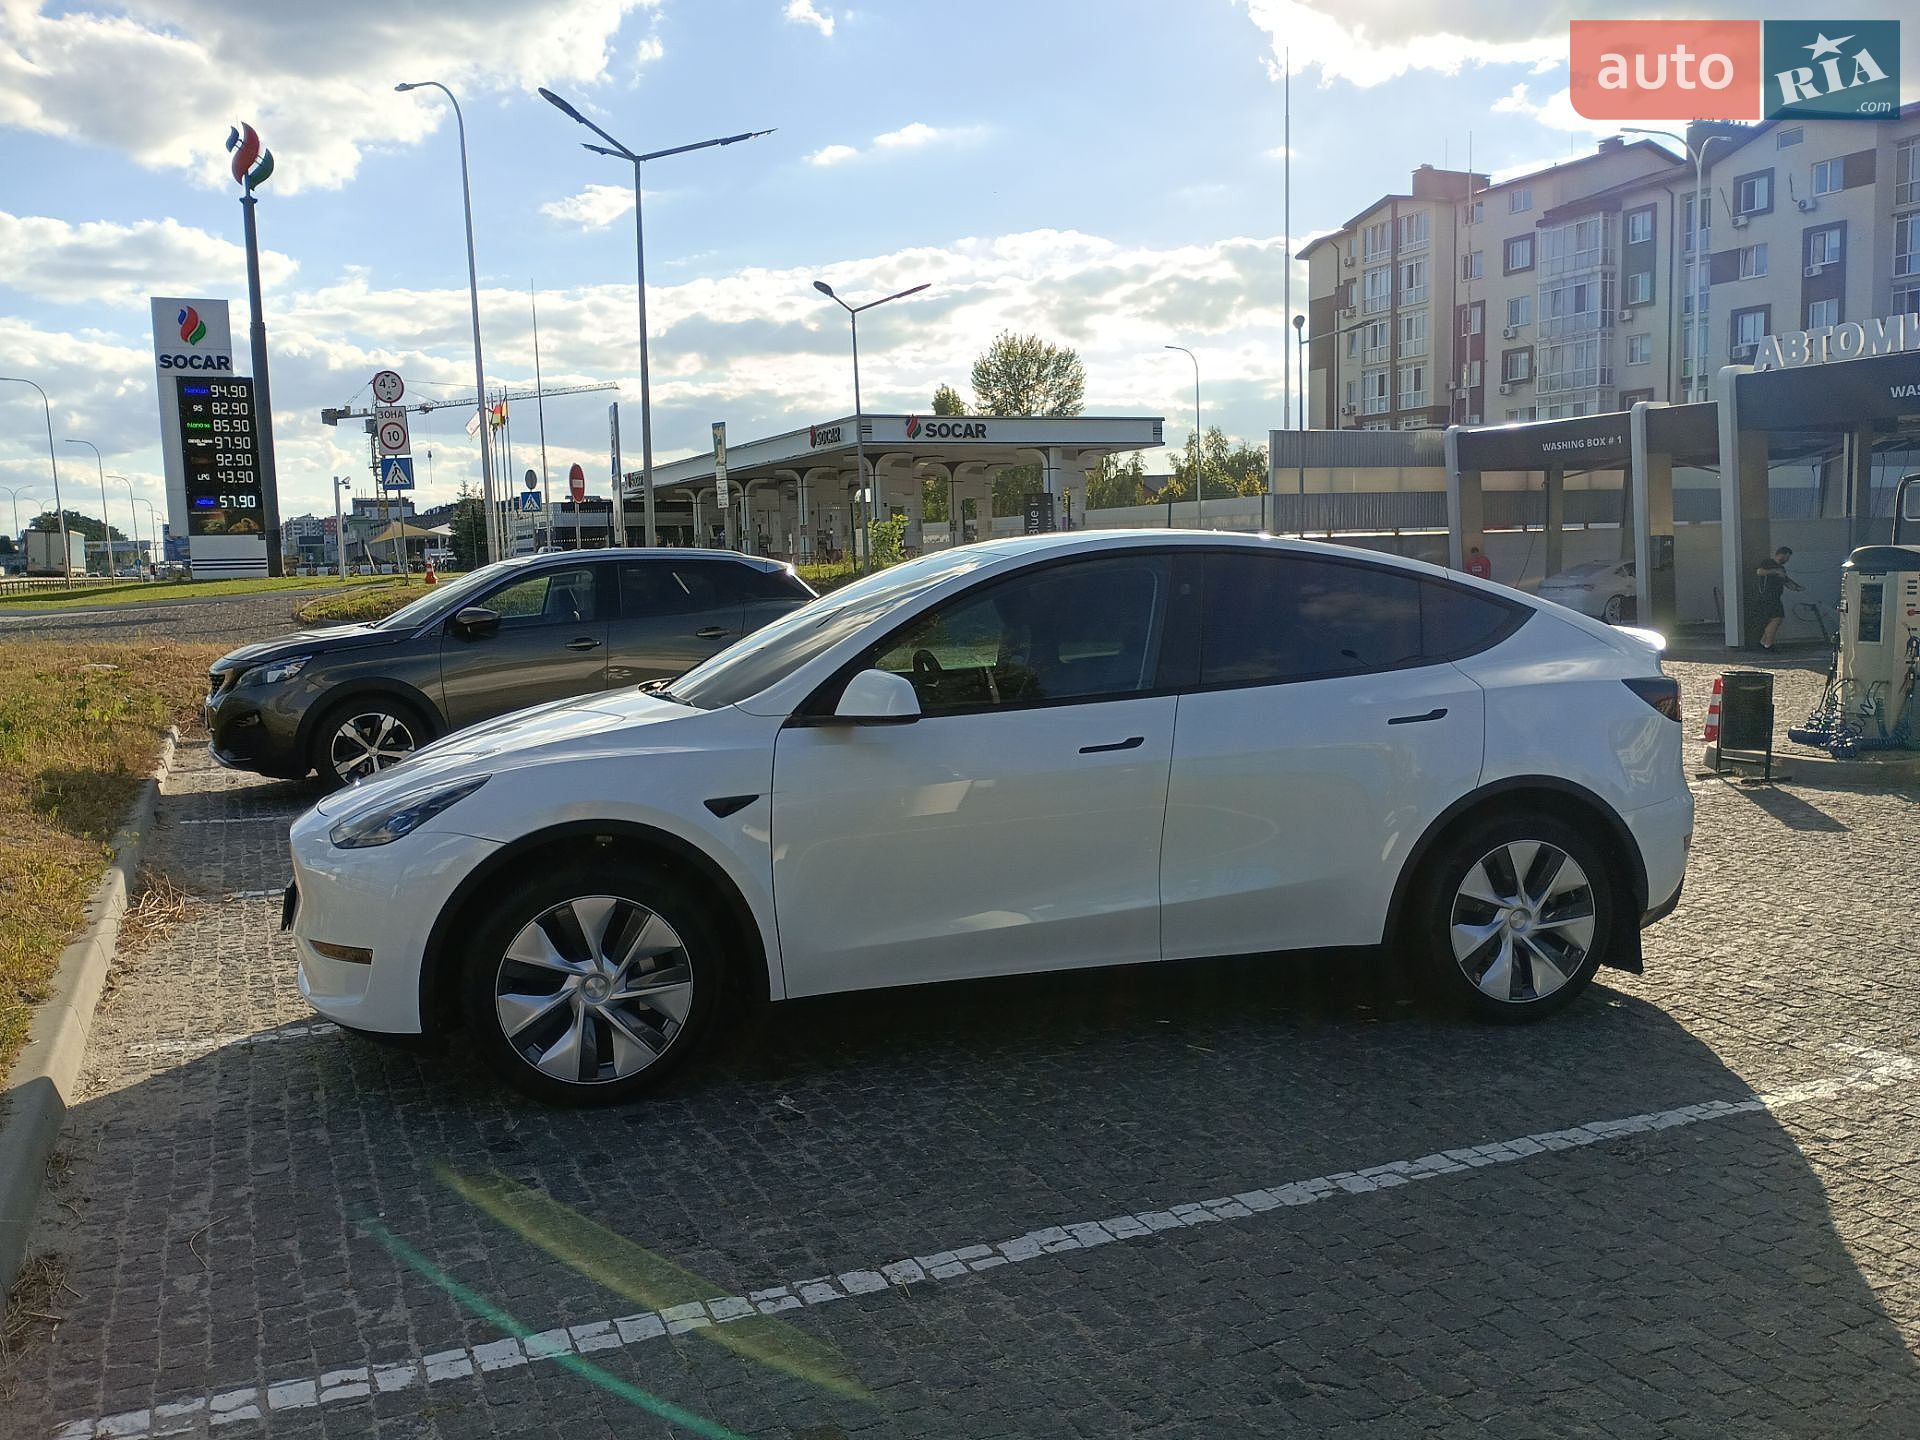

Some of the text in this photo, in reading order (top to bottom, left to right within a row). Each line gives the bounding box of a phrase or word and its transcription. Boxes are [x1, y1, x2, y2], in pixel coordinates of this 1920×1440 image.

[159, 354, 231, 370] SOCAR
[210, 385, 247, 398] 94.90
[211, 402, 248, 415] 82.90
[378, 410, 404, 419] ЗОНА
[213, 419, 250, 432] 85.90
[925, 423, 987, 439] SOCAR
[387, 430, 400, 441] 10
[816, 426, 841, 446] SOCAR
[214, 436, 251, 449] 97.90
[1542, 440, 1585, 451] WASHING
[1586, 437, 1606, 447] BOX
[1617, 435, 1622, 444] 1
[215, 454, 253, 466] 92.90
[217, 470, 254, 483] 43.90
[219, 495, 256, 508] 57.90
[1028, 510, 1039, 535] Blue
